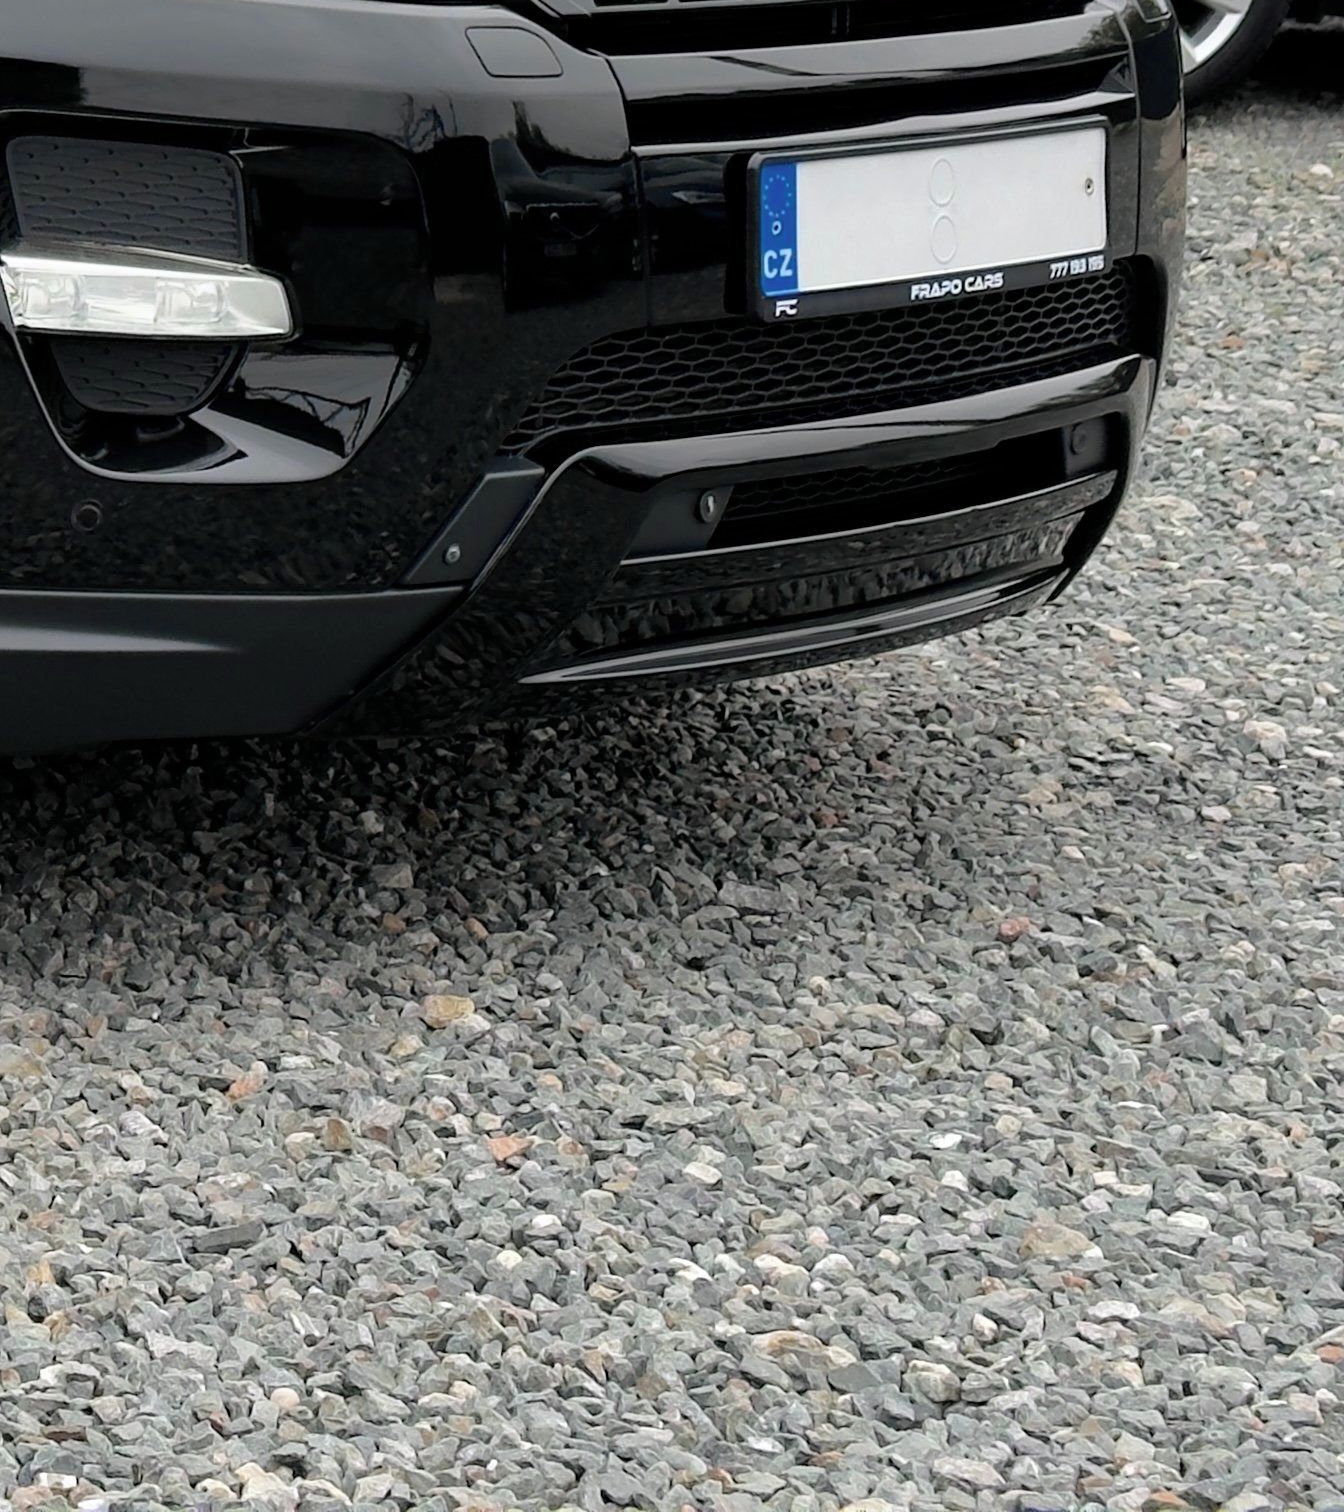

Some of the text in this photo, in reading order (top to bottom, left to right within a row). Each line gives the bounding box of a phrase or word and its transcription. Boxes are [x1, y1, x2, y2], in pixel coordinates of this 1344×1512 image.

[763, 248, 793, 279] CZ
[1049, 260, 1070, 279] 777
[910, 271, 1005, 301] FRAPO CARS
